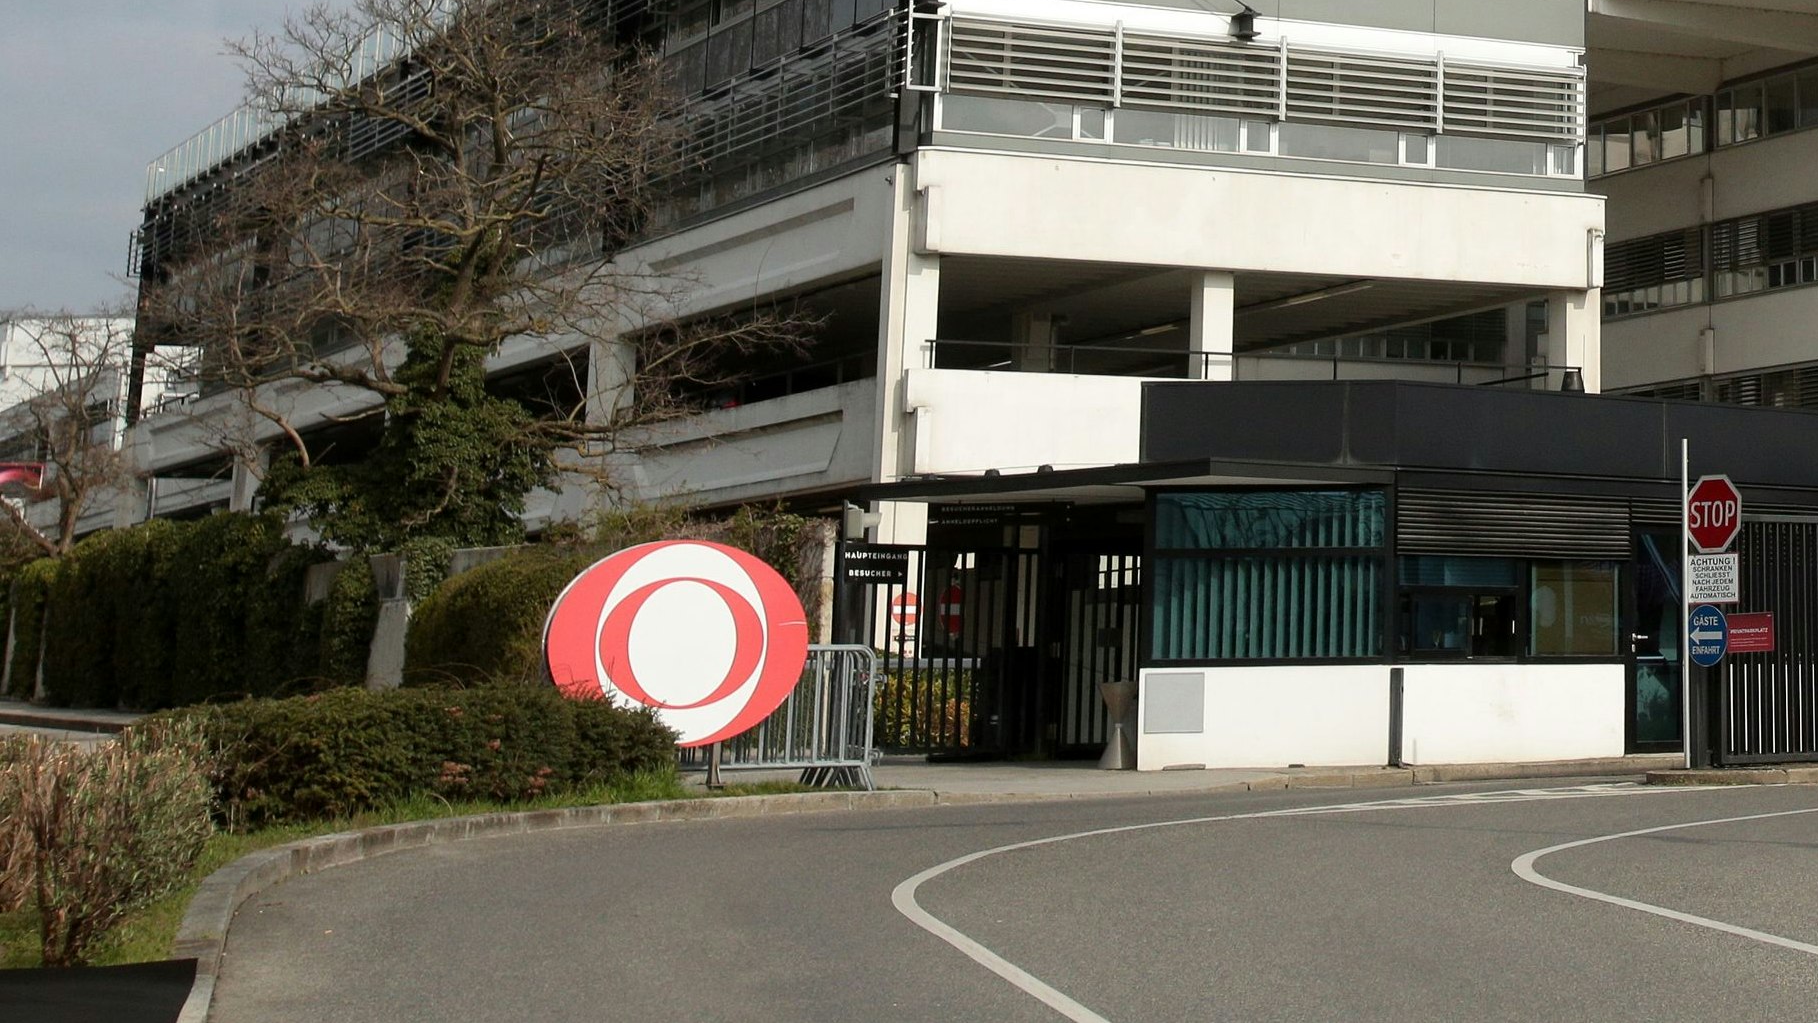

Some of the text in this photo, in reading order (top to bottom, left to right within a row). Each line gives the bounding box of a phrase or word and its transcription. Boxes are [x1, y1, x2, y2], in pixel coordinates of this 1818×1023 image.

[1690, 500, 1736, 528] STOP
[844, 551, 908, 560] HAUPTEINGANG
[1690, 558, 1730, 566] ACHTUNG
[848, 569, 892, 577] BESUCHER
[1692, 565, 1733, 573] SCHRANKEN
[1693, 615, 1719, 626] GÄSTE
[1692, 645, 1721, 655] EINFAHRT
